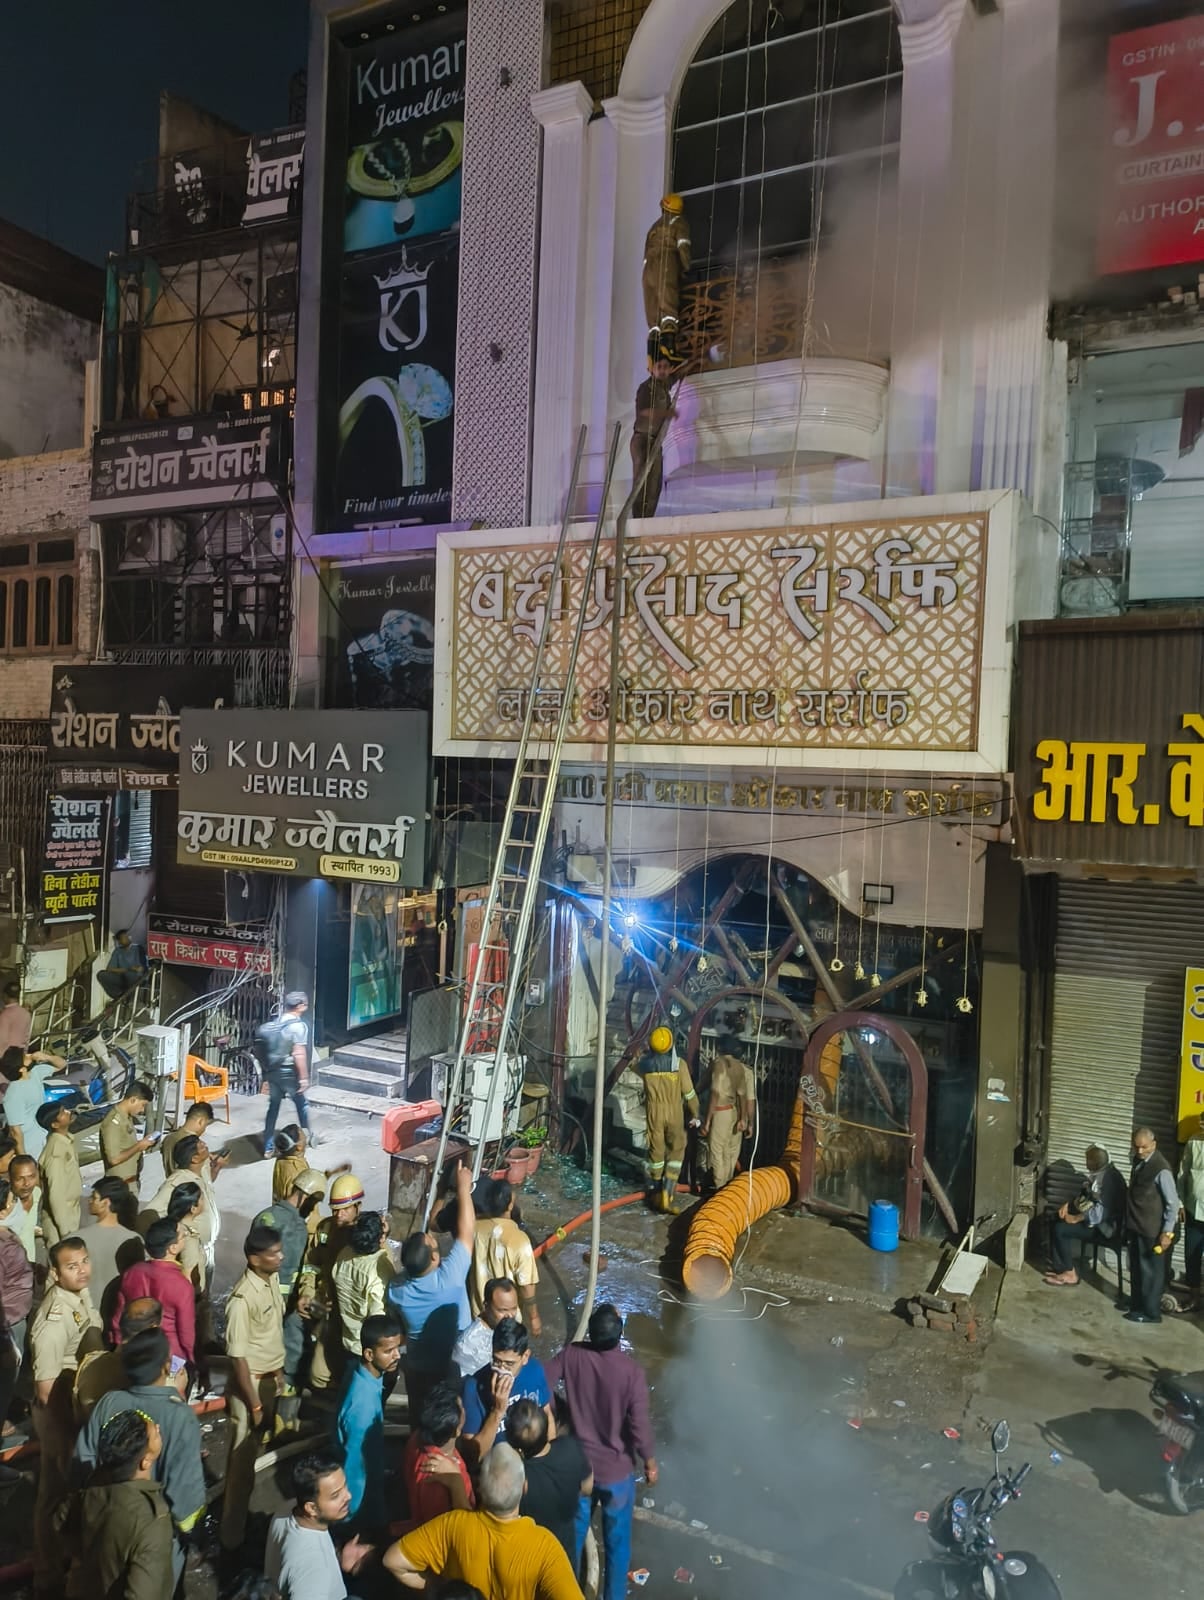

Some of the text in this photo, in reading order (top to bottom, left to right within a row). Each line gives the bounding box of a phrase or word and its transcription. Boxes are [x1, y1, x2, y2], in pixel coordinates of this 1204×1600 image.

[1121, 42, 1176, 66] GSTIN
[357, 39, 465, 104] Kumar
[1123, 151, 1204, 180] CURTAIN
[114, 446, 184, 491] रोशन
[184, 426, 272, 481] ज्वैलर्स
[343, 487, 452, 514] Find your timele
[338, 580, 382, 599] Kumar
[708, 687, 783, 727] नाथ
[796, 669, 910, 729] सर्राफ
[51, 697, 120, 750] रोशन
[228, 739, 385, 773] KUMAR
[125, 770, 169, 786] रोशन
[242, 774, 368, 800] JEWELLERS
[50, 795, 103, 816] रोशन
[51, 817, 100, 839] ज्वैलर्स
[177, 809, 416, 859] कुमार ज्वैलर्स
[44, 872, 100, 892] हिना लेडीज
[45, 890, 98, 914] ब्यूटी पार्लर
[166, 920, 209, 935] रोशन
[175, 939, 208, 960] किशोर
[214, 948, 238, 963] एण्ड
